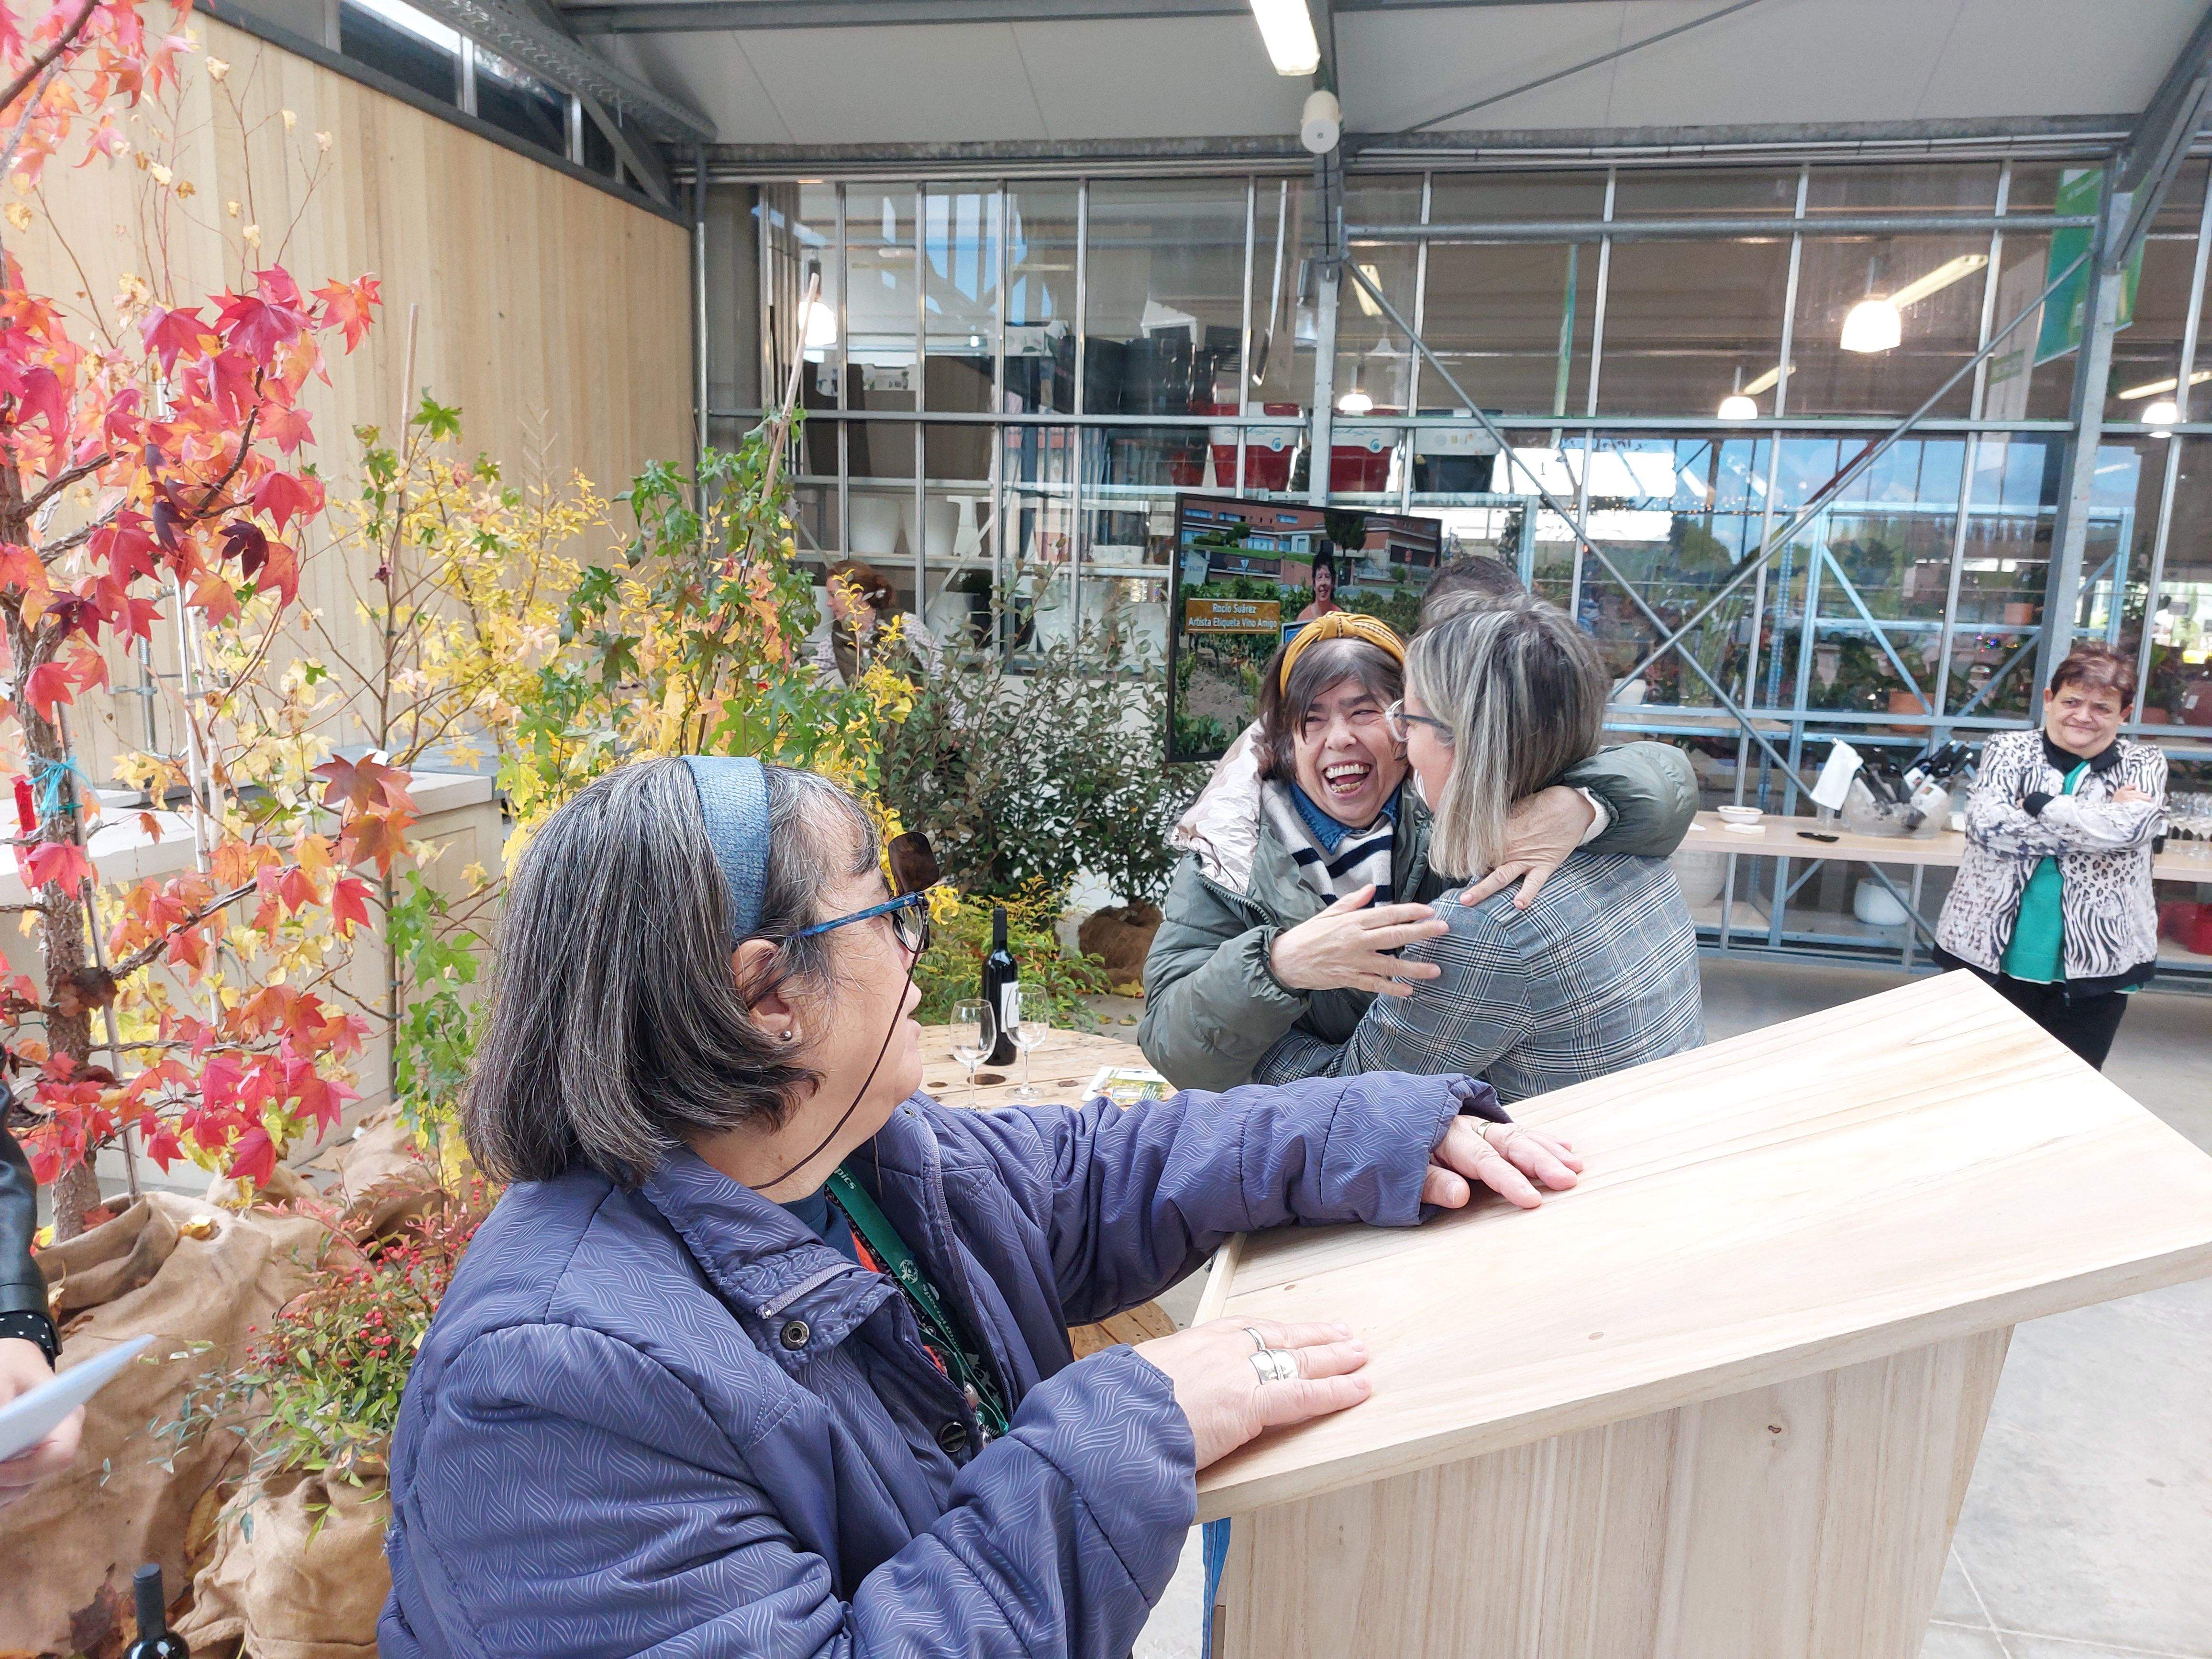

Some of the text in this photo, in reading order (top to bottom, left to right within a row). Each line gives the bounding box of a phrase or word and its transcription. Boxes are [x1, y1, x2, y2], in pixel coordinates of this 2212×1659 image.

[1212, 603, 1257, 614] Rocío Suárez
[1188, 617, 1277, 630] Artista Etiqueta Vino Amigo
